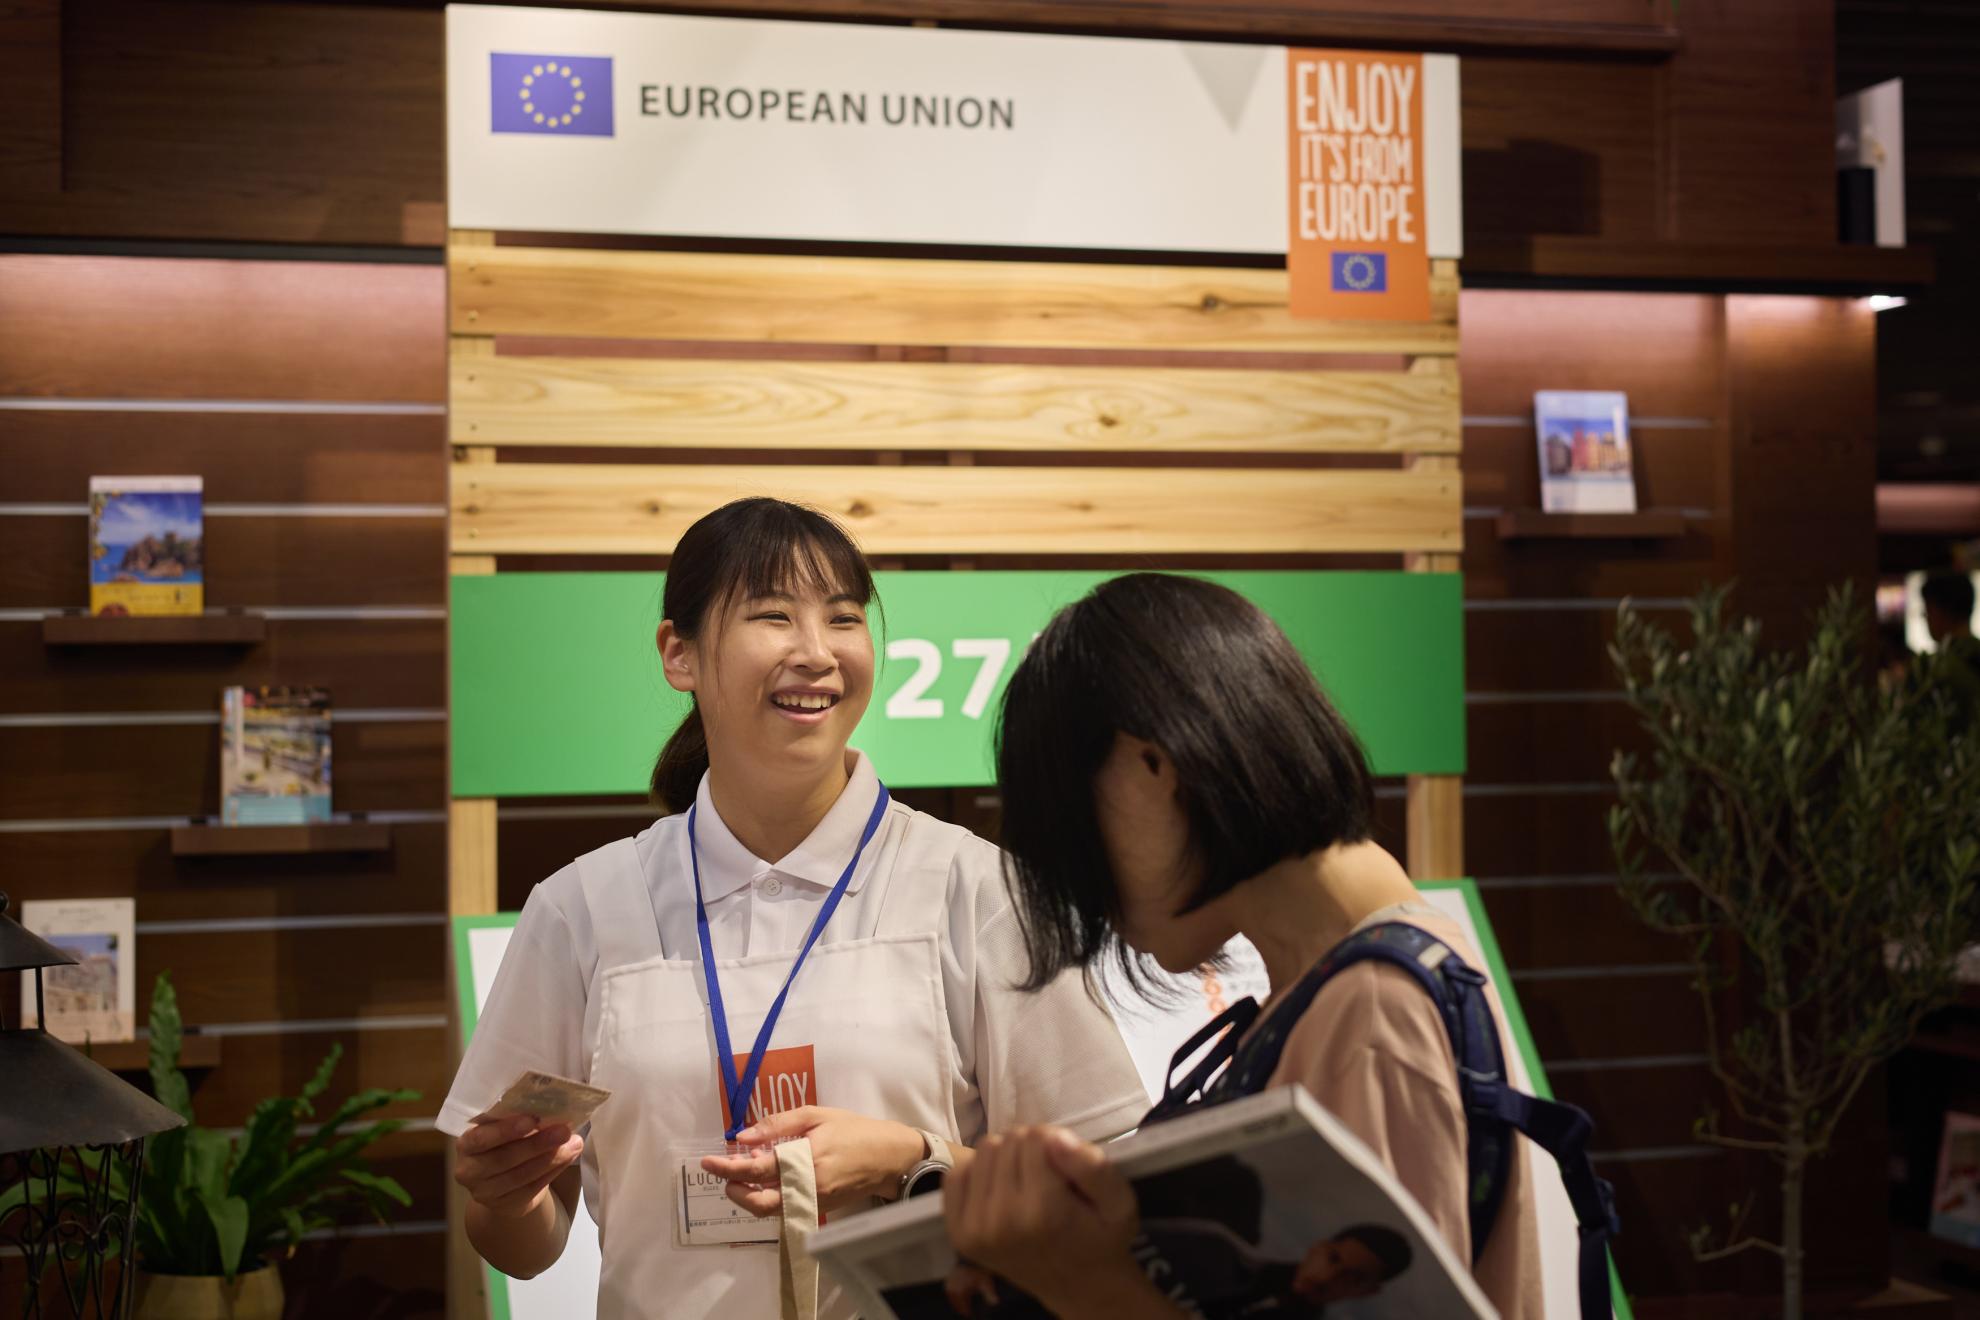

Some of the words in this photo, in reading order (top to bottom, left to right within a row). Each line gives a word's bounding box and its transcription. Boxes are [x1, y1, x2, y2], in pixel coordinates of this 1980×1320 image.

[639, 83, 867, 125] EUROPEAN
[882, 94, 1014, 130] UNION
[1296, 60, 1415, 134] ENJOY
[1300, 132, 1346, 182] IT'S
[1351, 135, 1412, 183] FROM
[1299, 182, 1415, 242] EUROPE
[885, 631, 1041, 720] 27
[745, 1071, 808, 1124] NJOY
